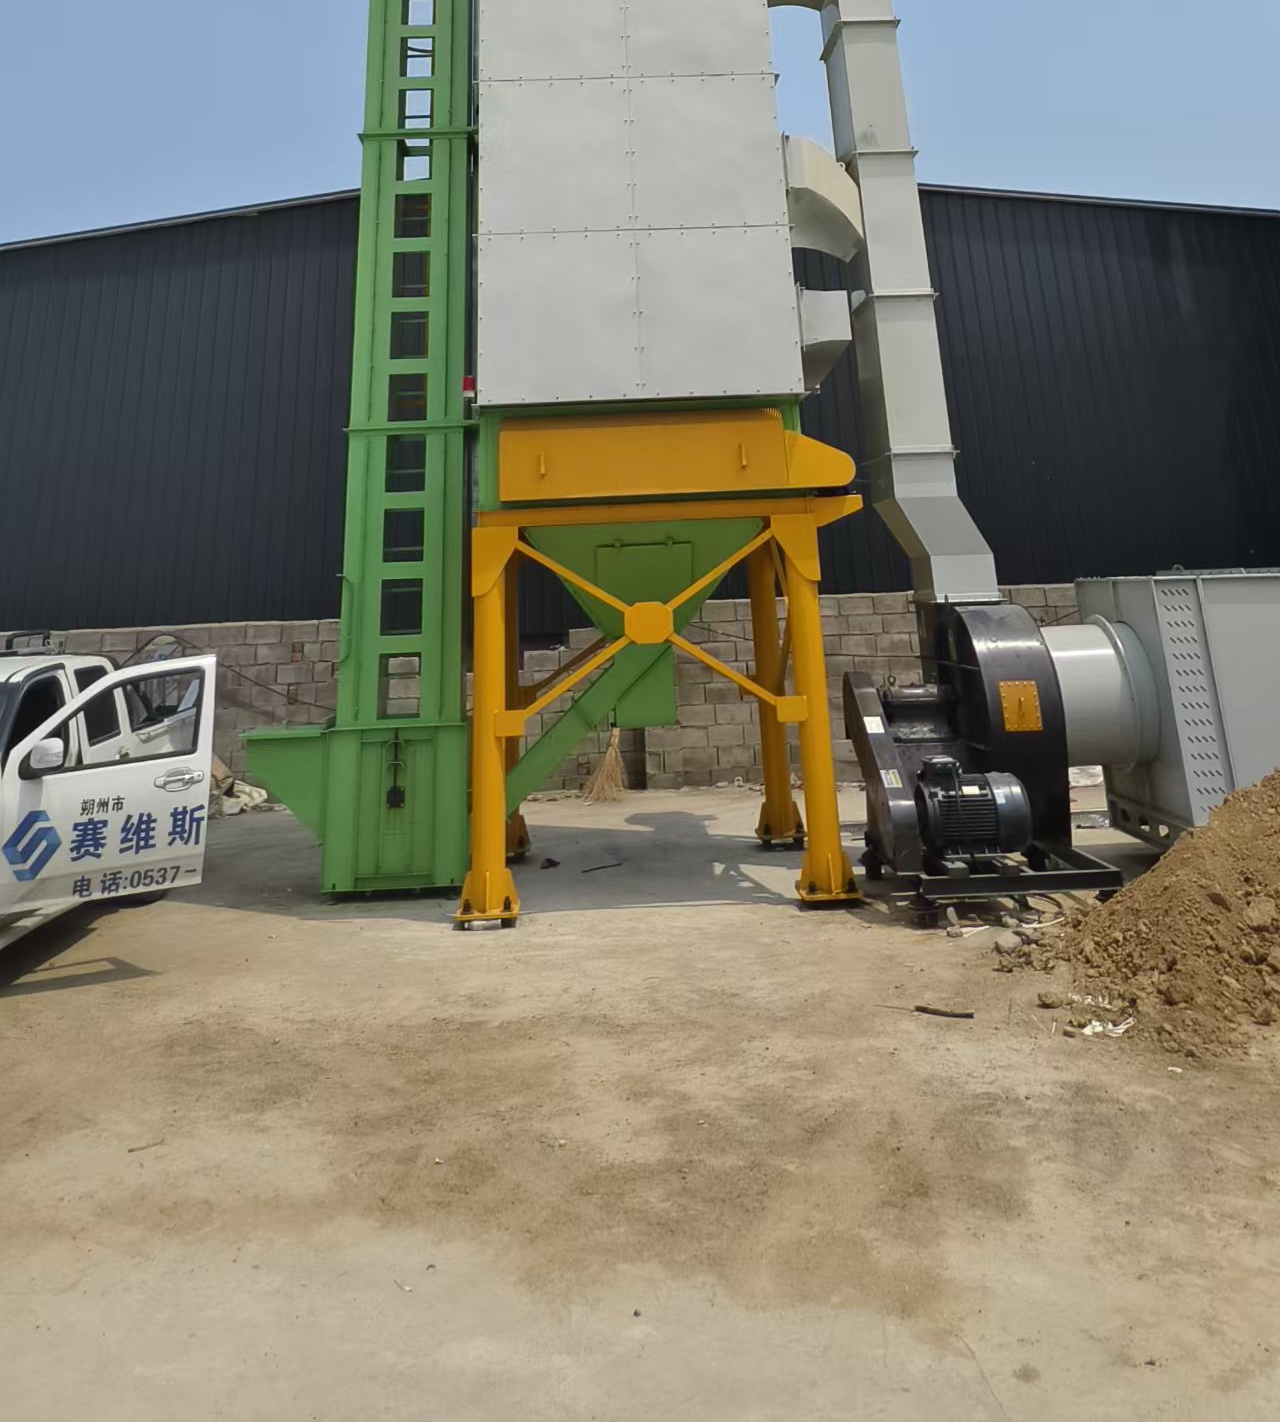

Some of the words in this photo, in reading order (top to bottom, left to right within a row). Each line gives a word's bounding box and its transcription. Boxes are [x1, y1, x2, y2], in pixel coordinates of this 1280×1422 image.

[80, 795, 126, 816] 朔州市
[69, 804, 205, 862] 赛维斯
